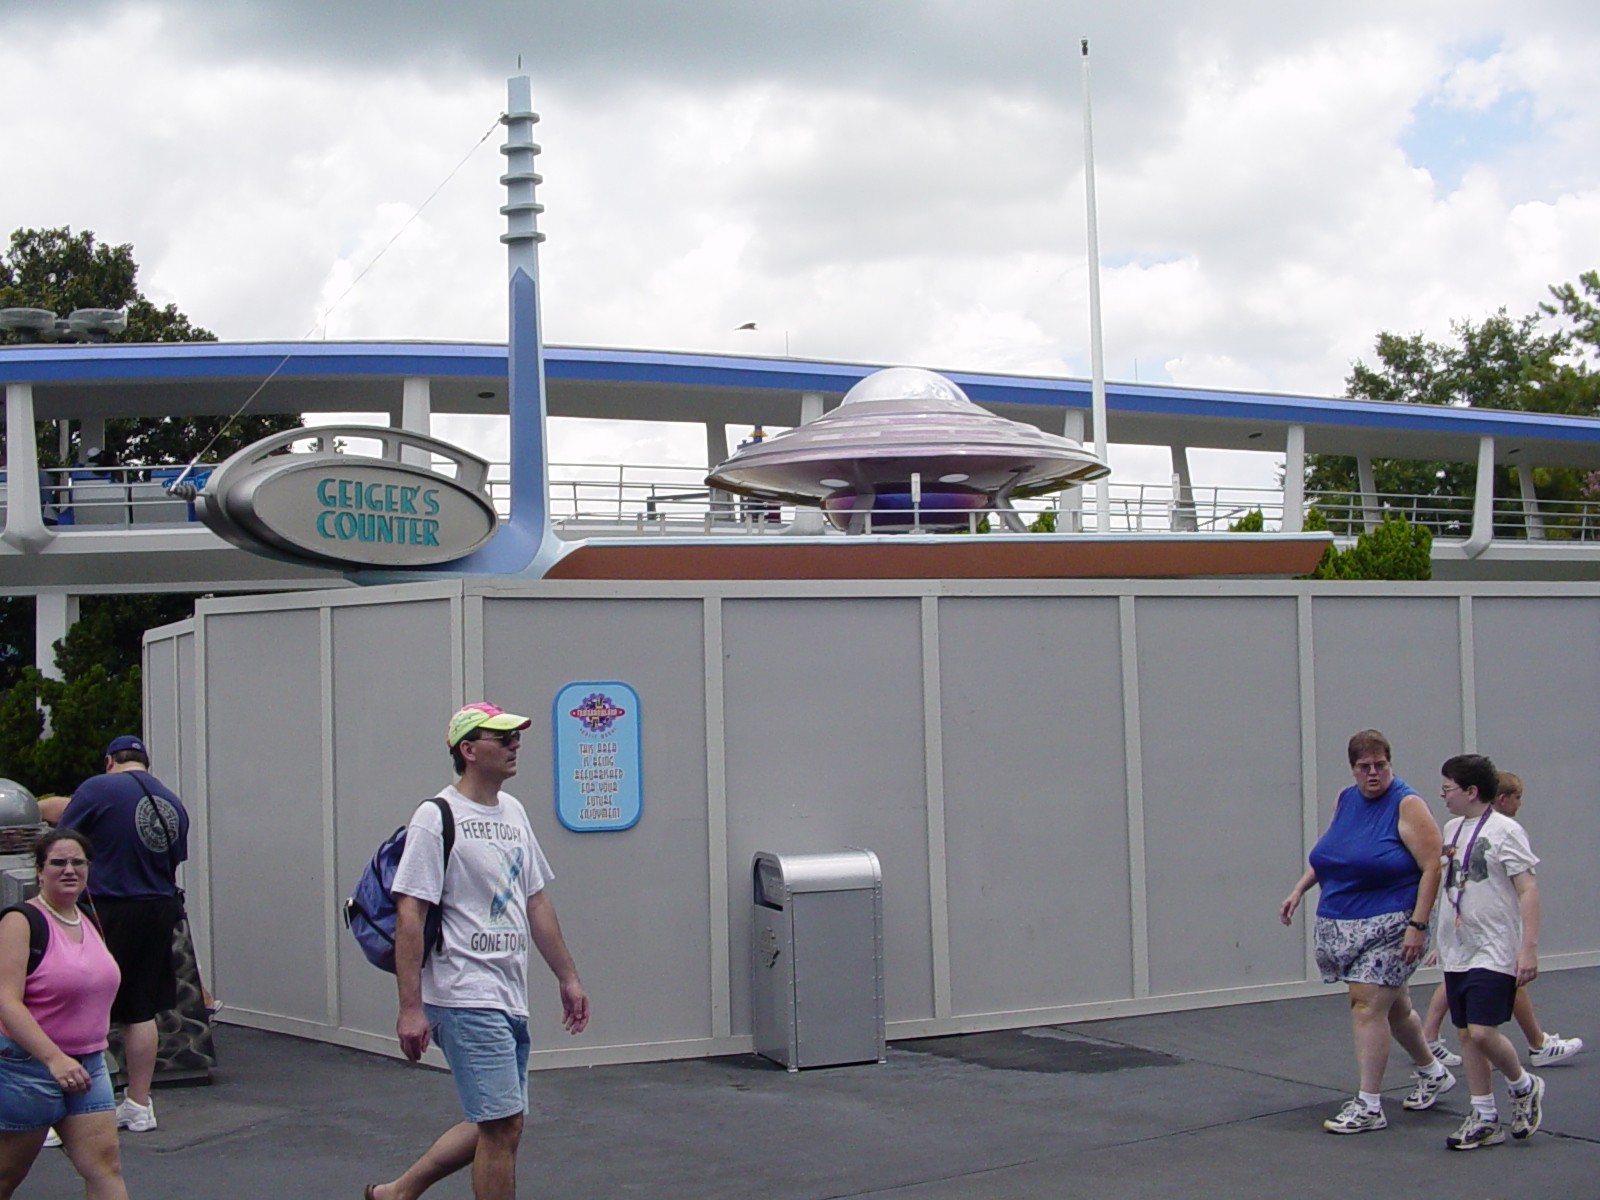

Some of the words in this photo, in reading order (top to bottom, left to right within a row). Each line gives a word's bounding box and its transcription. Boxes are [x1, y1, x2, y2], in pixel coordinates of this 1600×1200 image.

[316, 478, 440, 516] GEIGER'S
[316, 510, 440, 547] COUNTER
[460, 821, 493, 840] HERE
[470, 932, 501, 952] GONE
